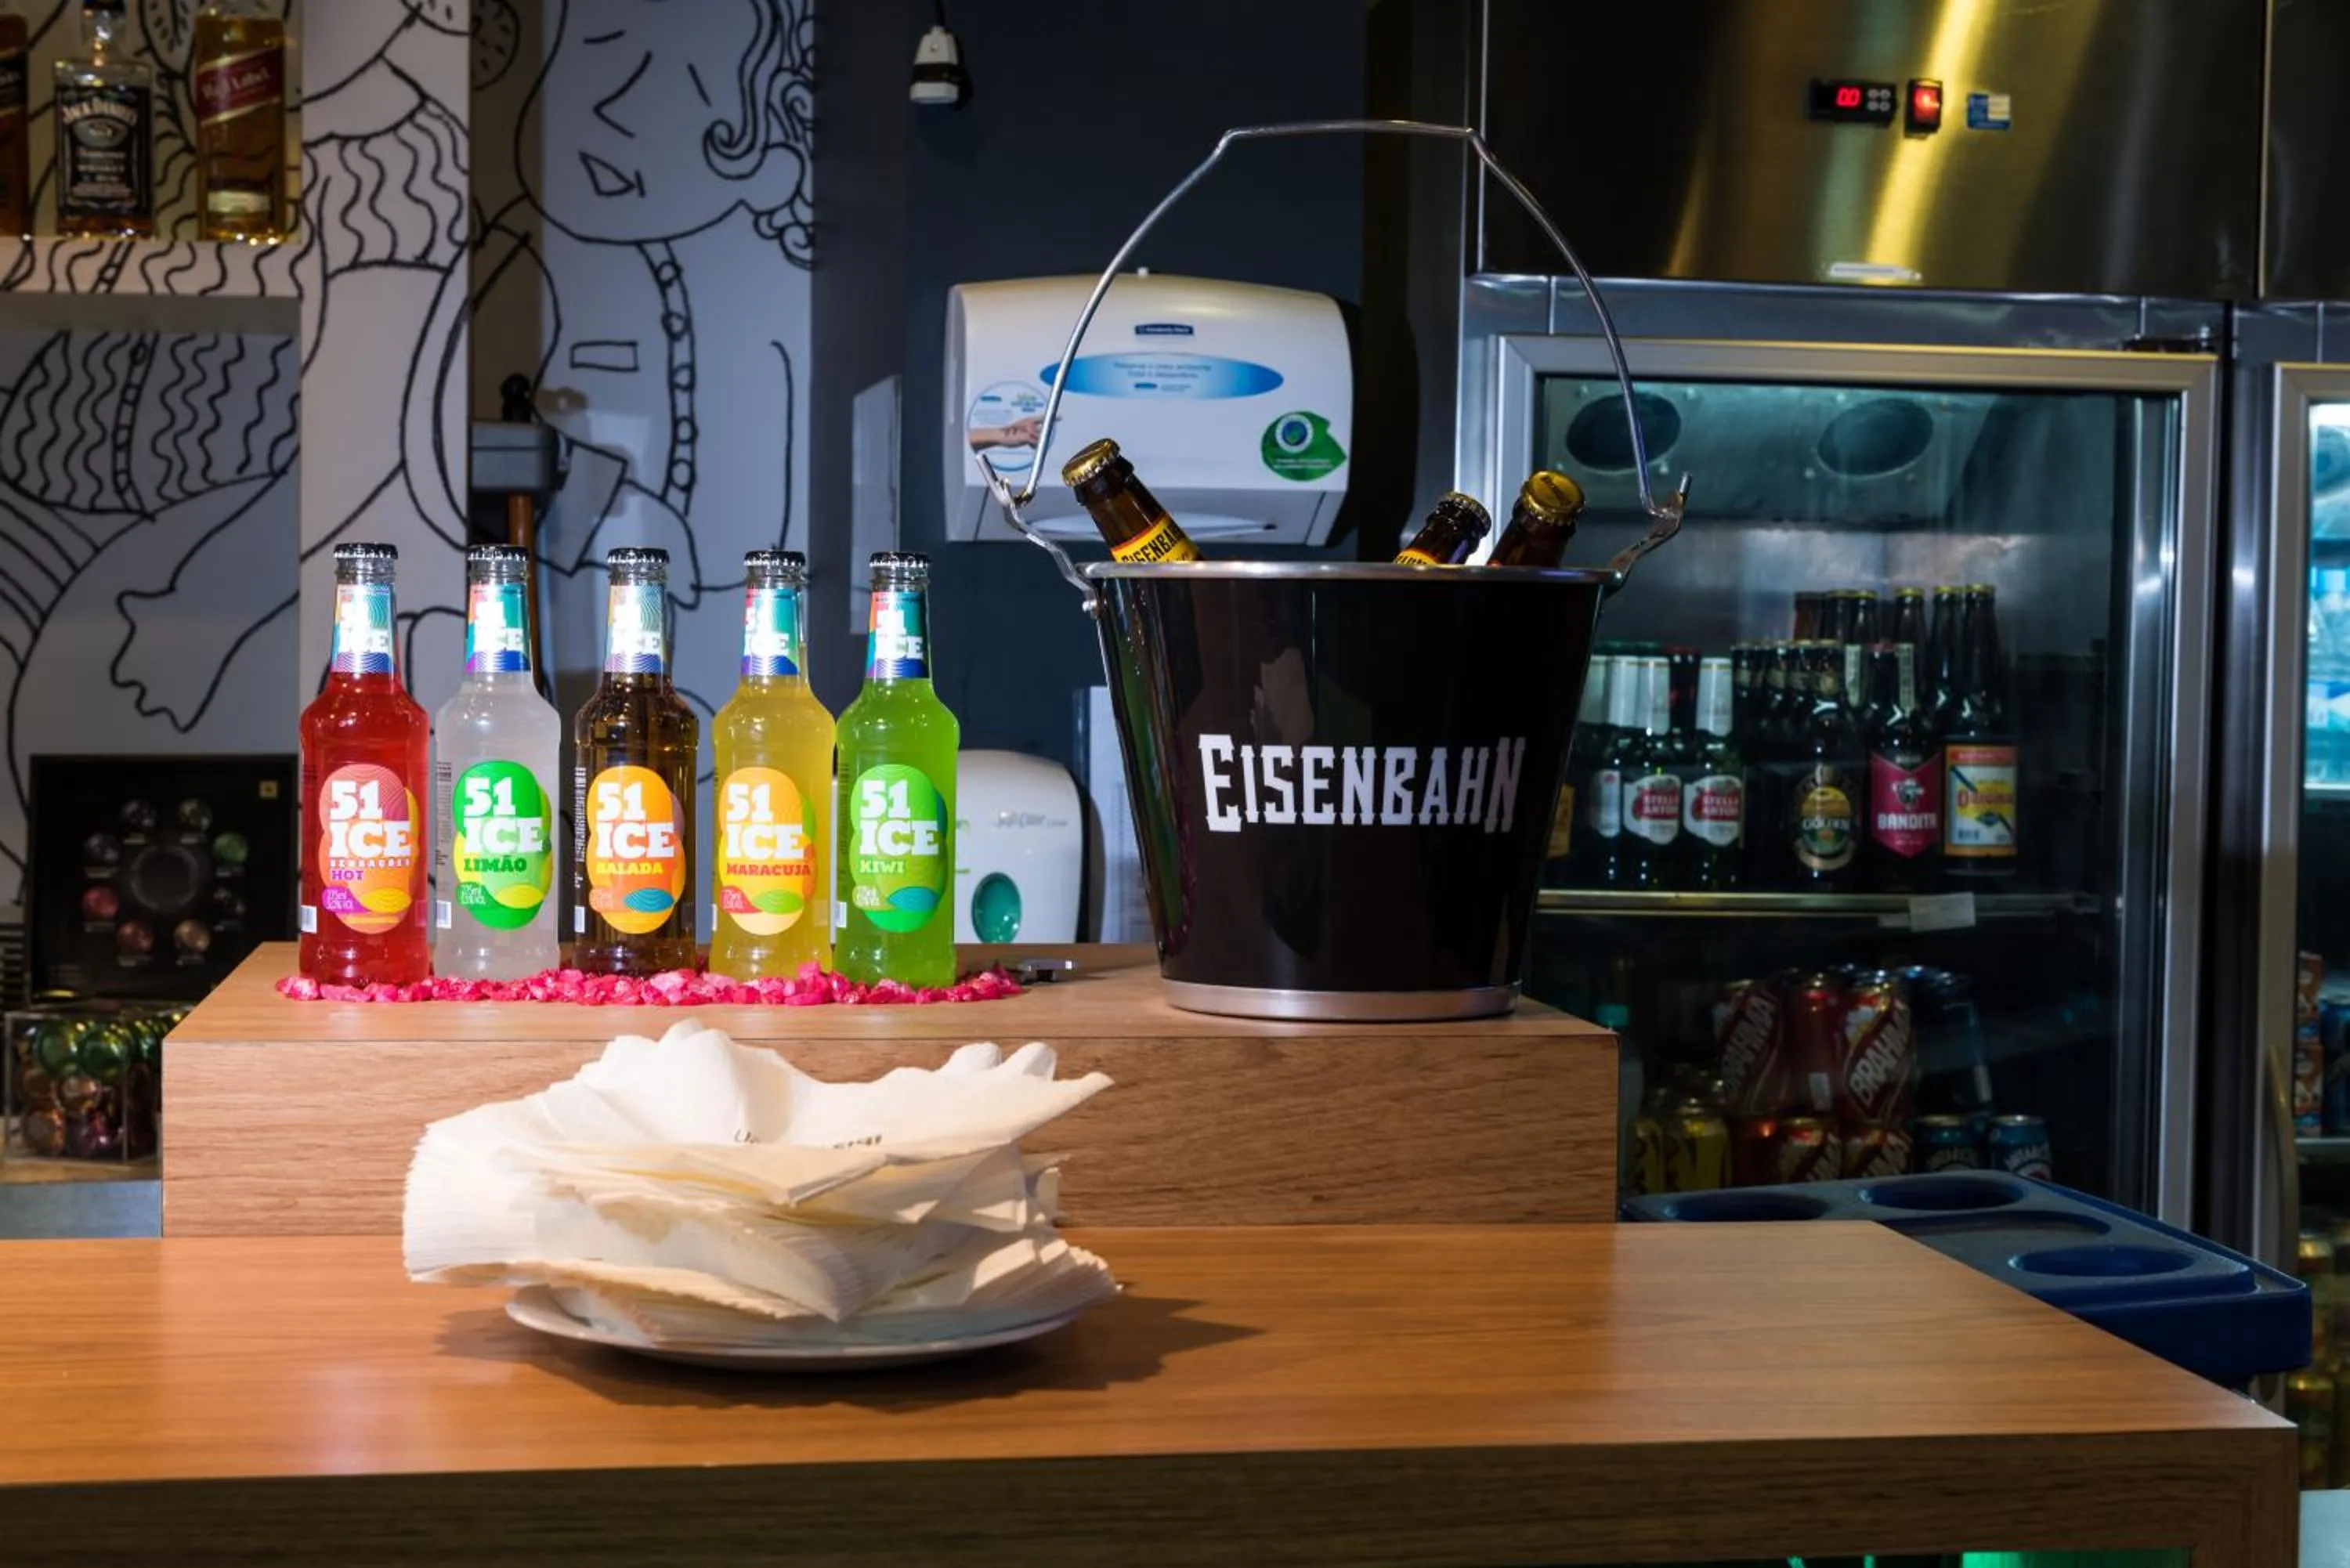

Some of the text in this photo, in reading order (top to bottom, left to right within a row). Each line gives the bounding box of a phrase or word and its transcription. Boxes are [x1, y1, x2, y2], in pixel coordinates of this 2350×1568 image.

[330, 779, 383, 822] 51
[464, 776, 516, 817] 51
[595, 781, 646, 822] 51
[859, 779, 911, 819] 51
[1198, 733, 1527, 833] EISENBAHN
[726, 782, 774, 823] 51
[330, 820, 412, 858] ICE
[463, 817, 543, 854] ICE
[596, 822, 674, 859] ICE
[725, 823, 805, 861] ICE
[859, 819, 939, 857] ICE
[331, 870, 364, 881] HOT
[463, 854, 527, 873] LIMÃO
[859, 860, 905, 873] KIWI
